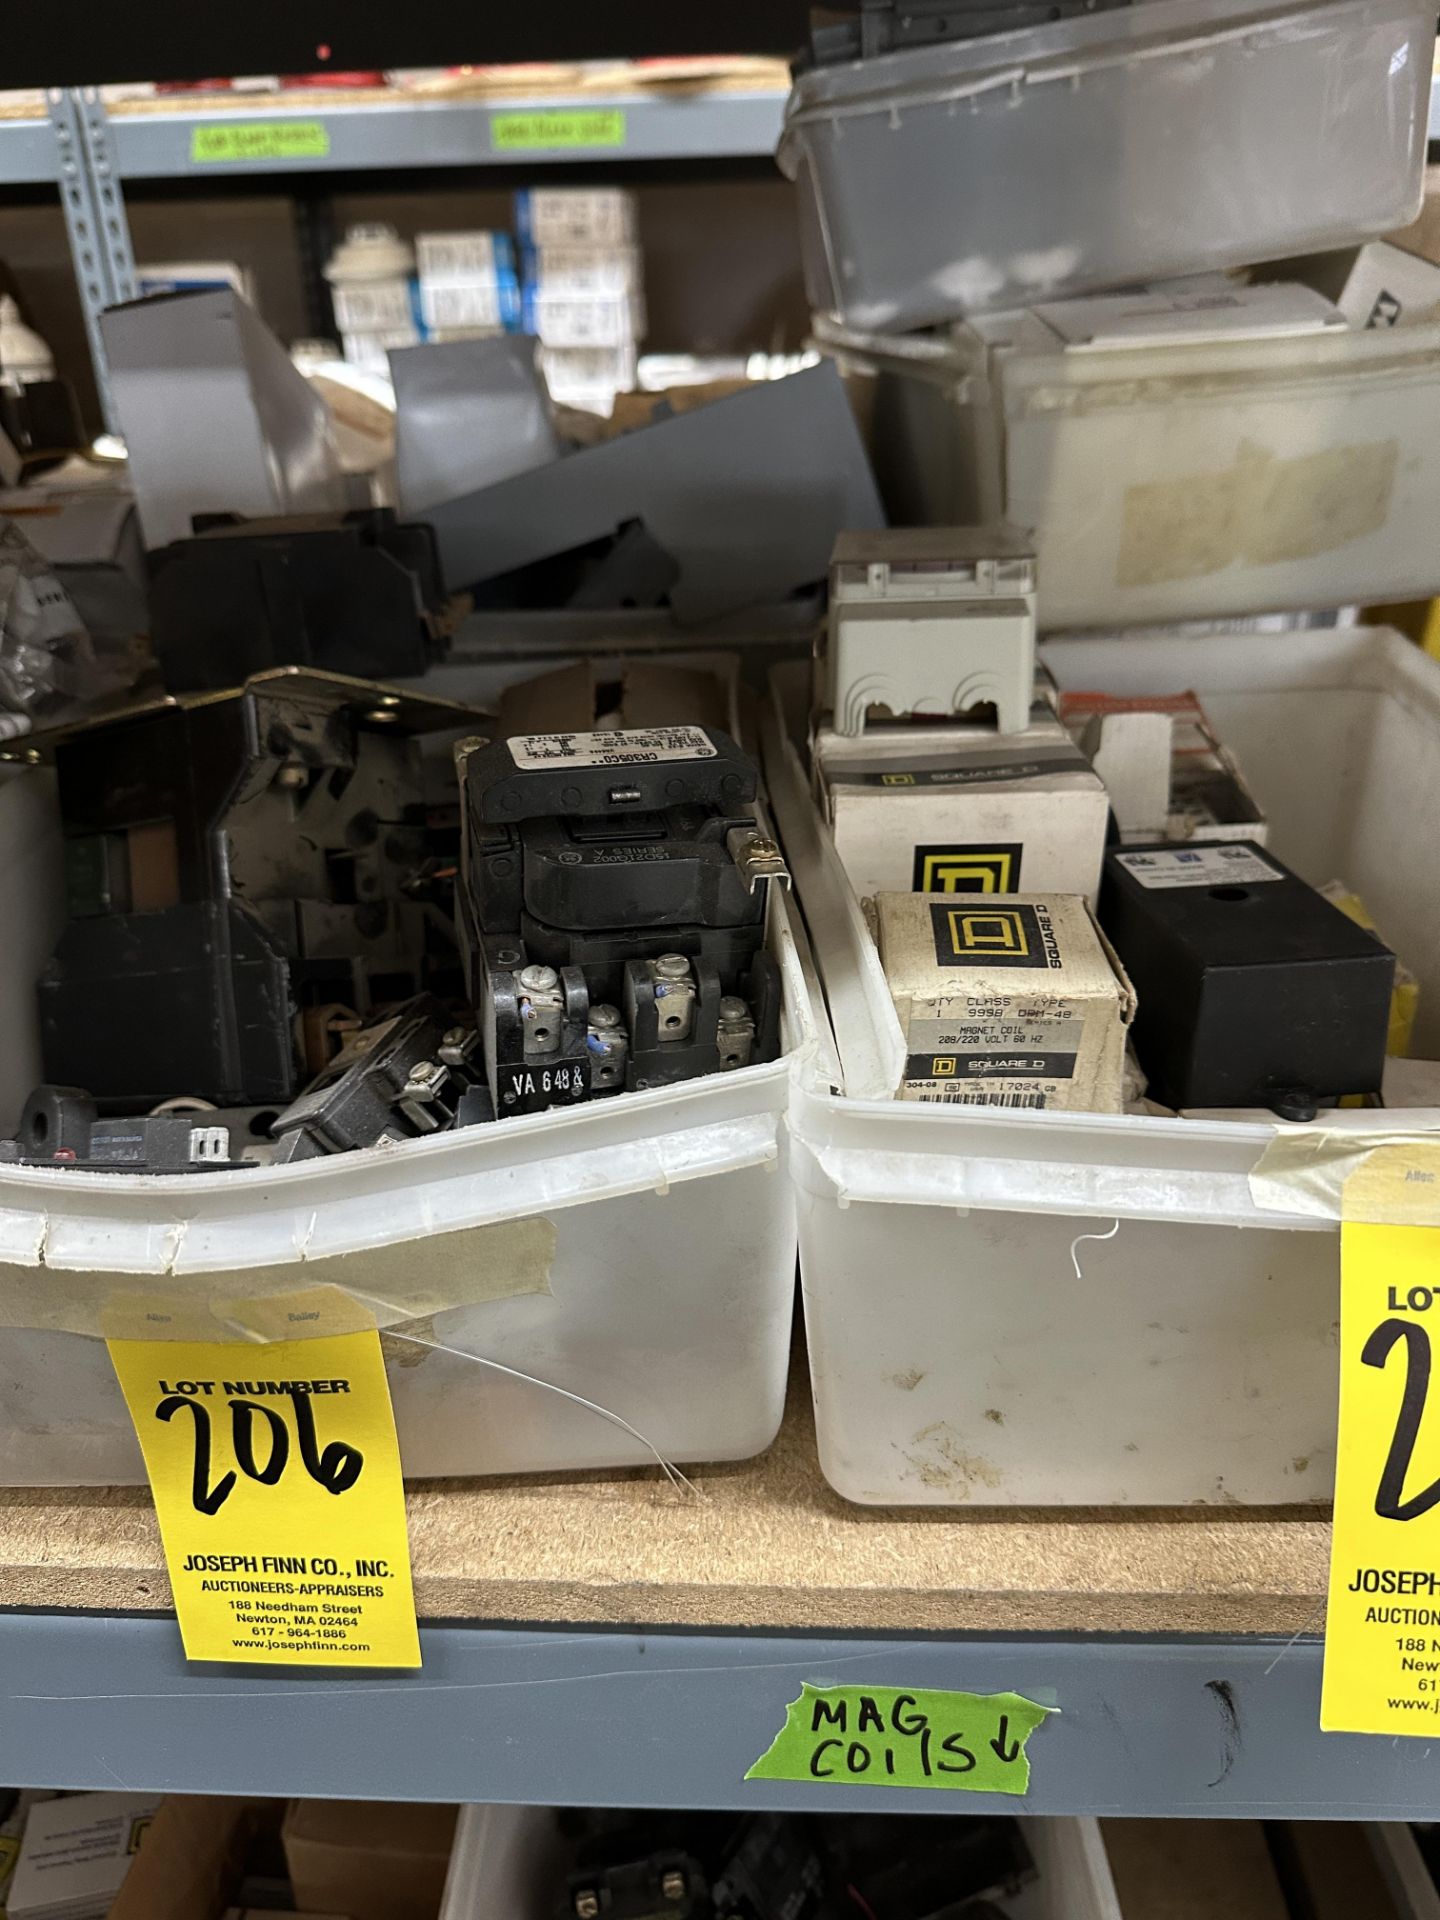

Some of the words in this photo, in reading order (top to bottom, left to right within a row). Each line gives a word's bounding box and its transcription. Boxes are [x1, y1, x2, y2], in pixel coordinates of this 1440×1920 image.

[1041, 916, 1062, 969] SQUARE
[967, 997, 1011, 1007] CLASS
[968, 1008, 1003, 1018] 9998
[959, 1026, 994, 1035] MAGNET
[1000, 1026, 1024, 1035] COIL
[938, 1035, 980, 1044] 208/220
[985, 1035, 1008, 1044] VOLT
[1013, 1035, 1025, 1044] 60
[1031, 1035, 1043, 1044] HZ
[968, 1060, 1027, 1068] SQUARE
[1033, 1060, 1045, 1068] D
[512, 1073, 536, 1096] VA
[158, 1380, 216, 1396] LOT
[222, 1379, 351, 1396] NUMBER
[155, 1384, 365, 1516] 206
[183, 1554, 258, 1573] JOSEPH
[261, 1556, 307, 1575] FINN
[311, 1557, 352, 1579] CO.,
[356, 1559, 395, 1578] INC.
[201, 1579, 384, 1598] AUCTIONEERS-APPRAISERS
[228, 1600, 252, 1611] 188
[255, 1601, 319, 1613] Needham
[322, 1602, 363, 1615] Street
[236, 1613, 291, 1626] Newton,
[294, 1615, 316, 1626] MA
[319, 1616, 358, 1627] 02464
[252, 1627, 275, 1637] 617
[287, 1628, 346, 1639] 964-1886
[232, 1637, 371, 1652] www.josephfinn.com
[1395, 1637, 1426, 1652] 188
[811, 1694, 929, 1736] MAG
